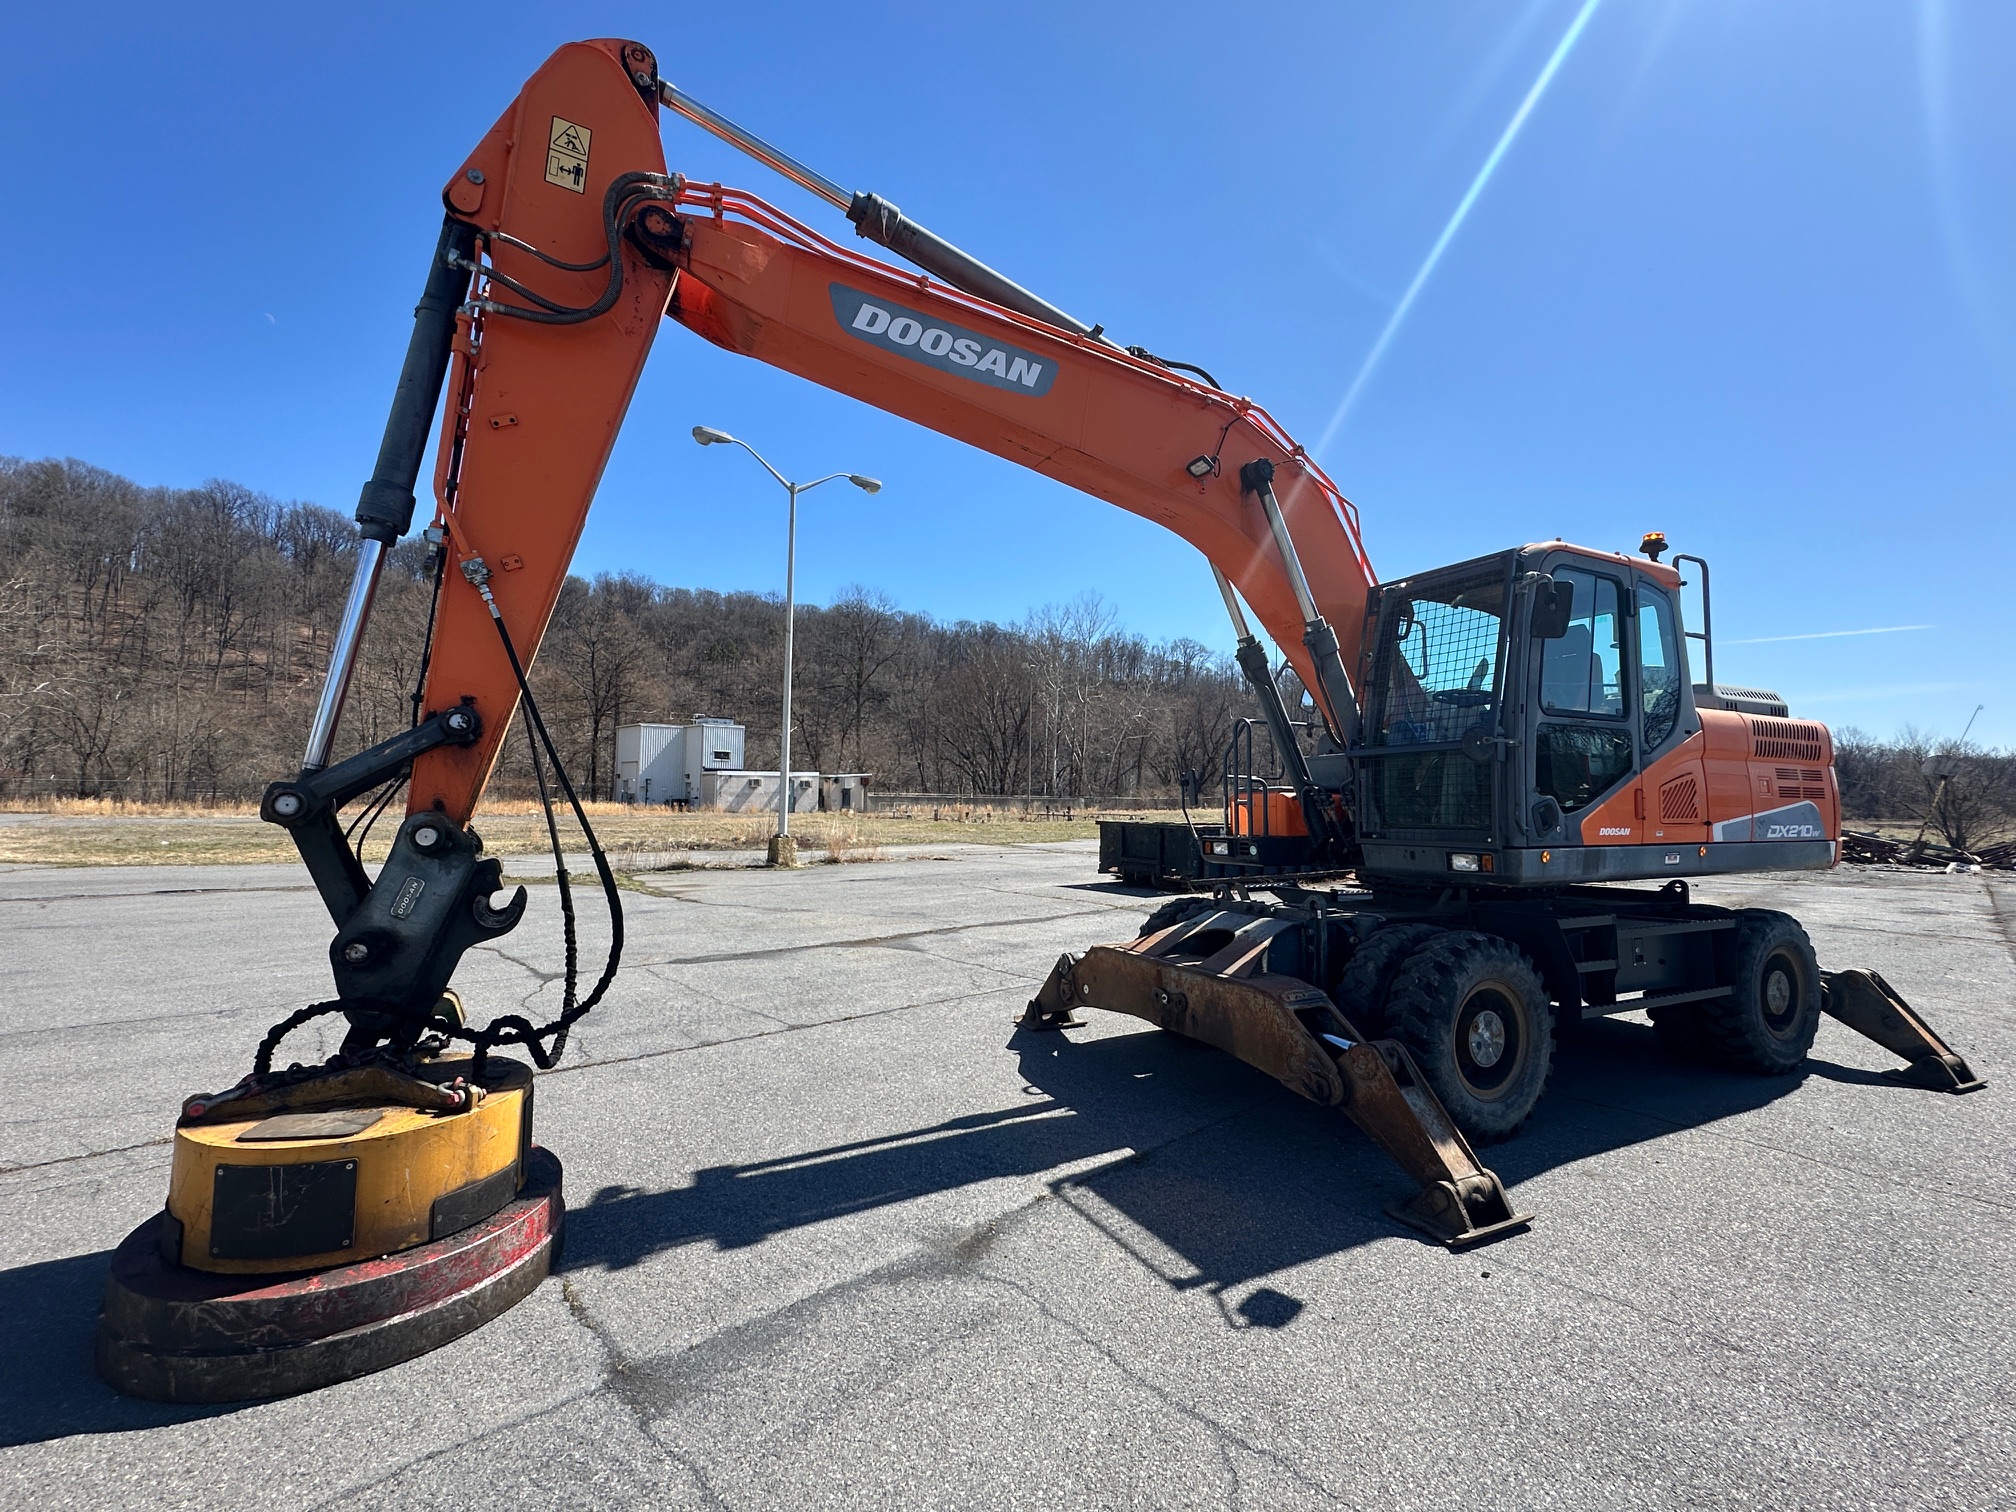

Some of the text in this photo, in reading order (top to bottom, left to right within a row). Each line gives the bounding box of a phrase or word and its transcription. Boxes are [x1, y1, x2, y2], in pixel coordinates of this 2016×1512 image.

[852, 303, 1042, 388] DOOSAN
[1599, 827, 1631, 836] DOOSAN
[397, 881, 419, 914] DOOSAN
